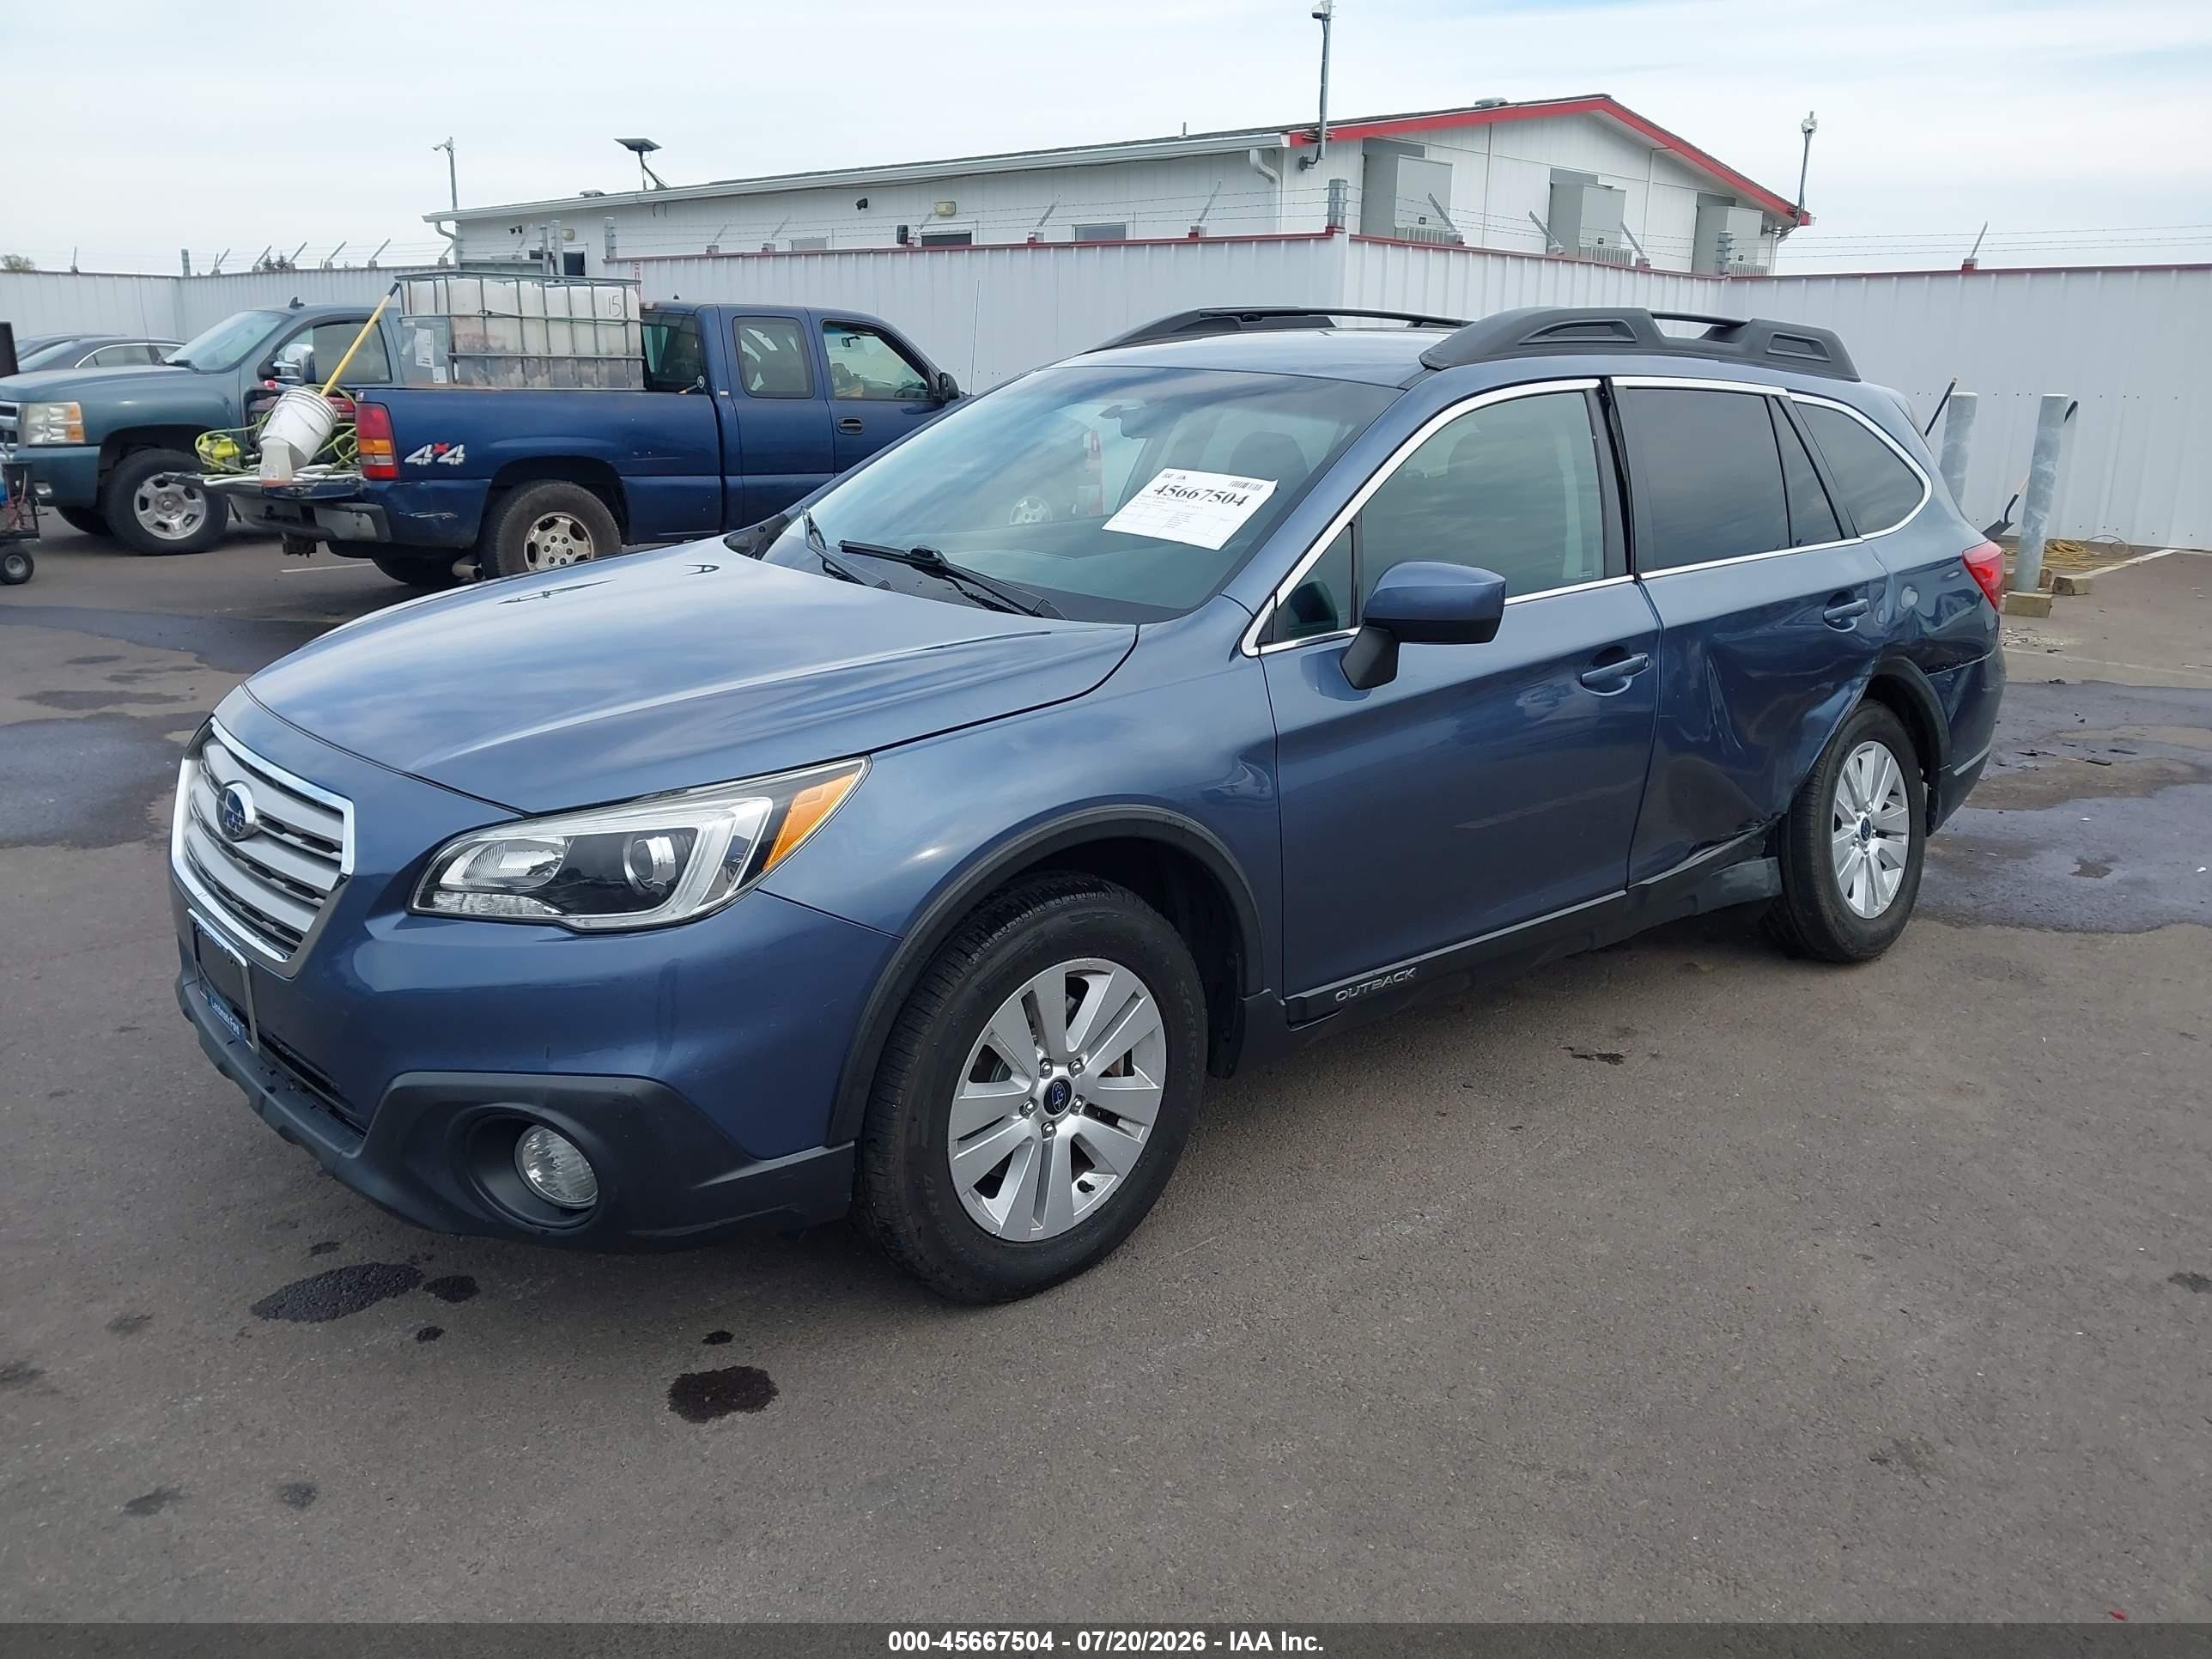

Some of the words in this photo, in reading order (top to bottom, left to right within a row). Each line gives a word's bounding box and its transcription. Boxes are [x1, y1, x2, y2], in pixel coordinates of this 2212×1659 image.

[607, 295, 623, 318] 15
[1153, 483, 1250, 507] 45667504
[1334, 967, 1417, 1003] OUTBACK
